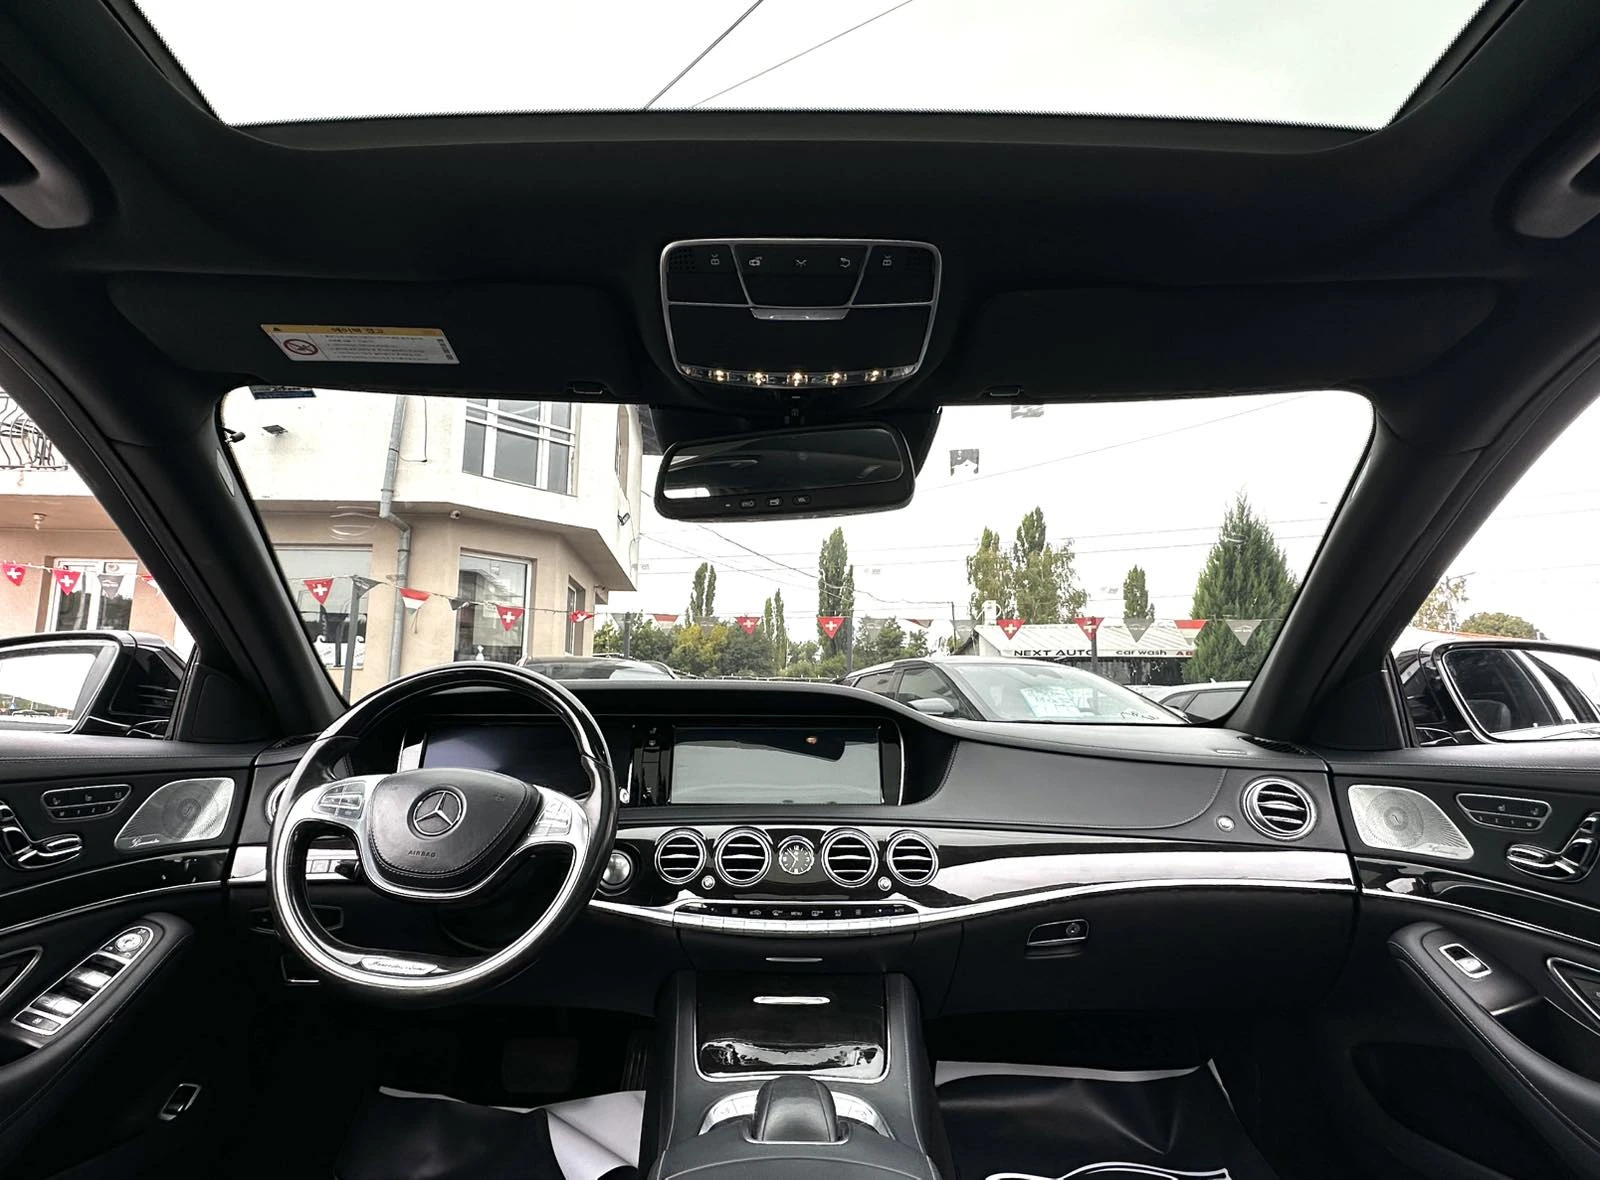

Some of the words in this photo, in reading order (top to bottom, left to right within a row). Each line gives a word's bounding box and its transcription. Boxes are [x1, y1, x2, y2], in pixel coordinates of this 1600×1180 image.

[1014, 649, 1053, 657] NEXT
[1055, 649, 1093, 657] AUTO
[1138, 648, 1167, 656] wash
[408, 850, 436, 858] AIRBAG
